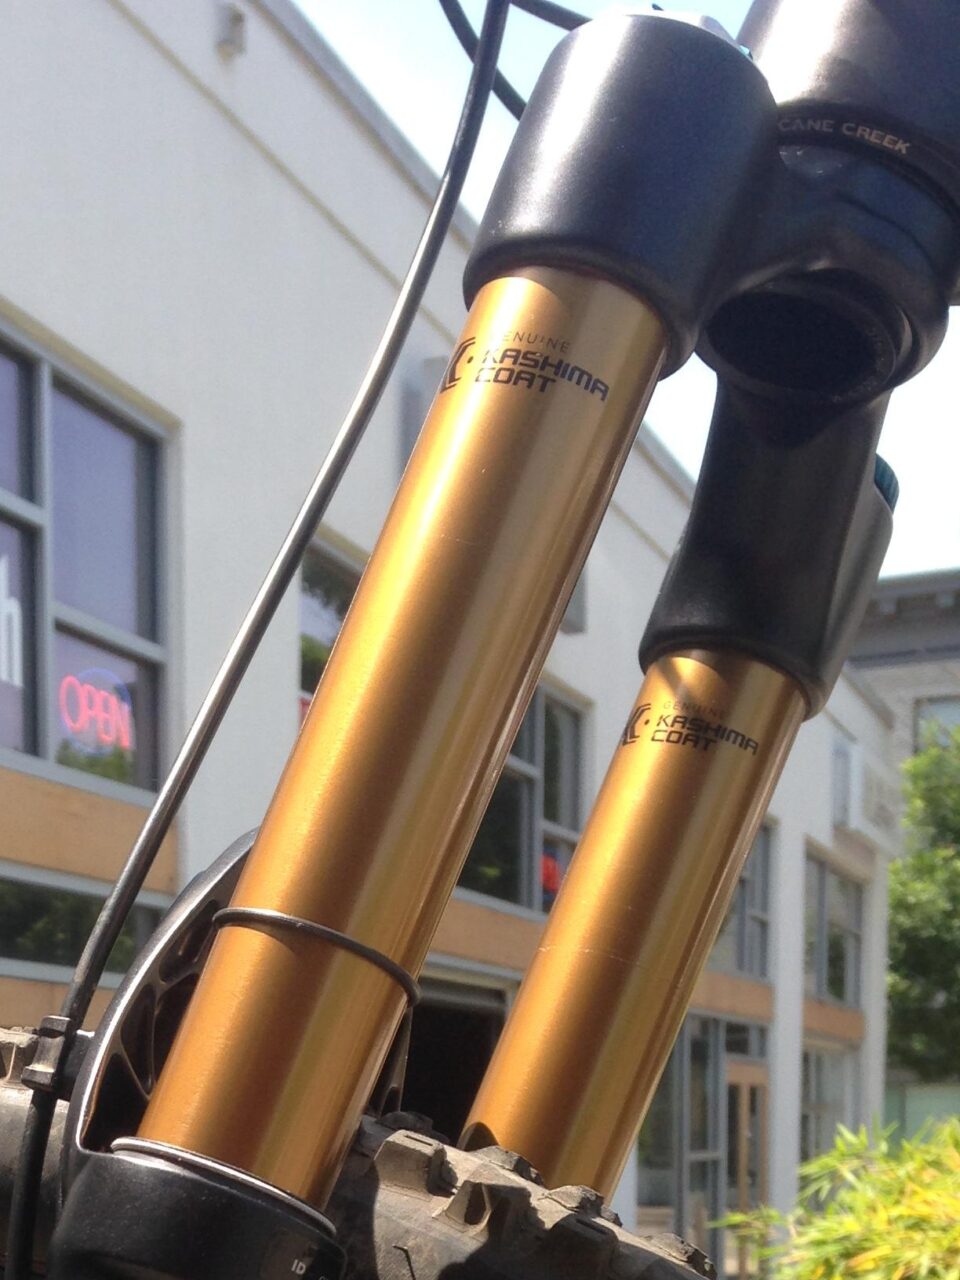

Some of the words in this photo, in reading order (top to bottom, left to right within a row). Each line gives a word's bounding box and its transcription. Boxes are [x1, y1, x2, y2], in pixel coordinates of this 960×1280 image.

[777, 118, 836, 133] CANE
[842, 121, 912, 155] CREEK
[495, 330, 573, 353] ENUINE
[474, 366, 557, 394] COAT
[481, 347, 610, 402] KASHIMA
[58, 673, 132, 751] OPEN
[650, 728, 718, 752] COAT
[656, 713, 760, 757] KASHIMA
[290, 1258, 307, 1276] ID
